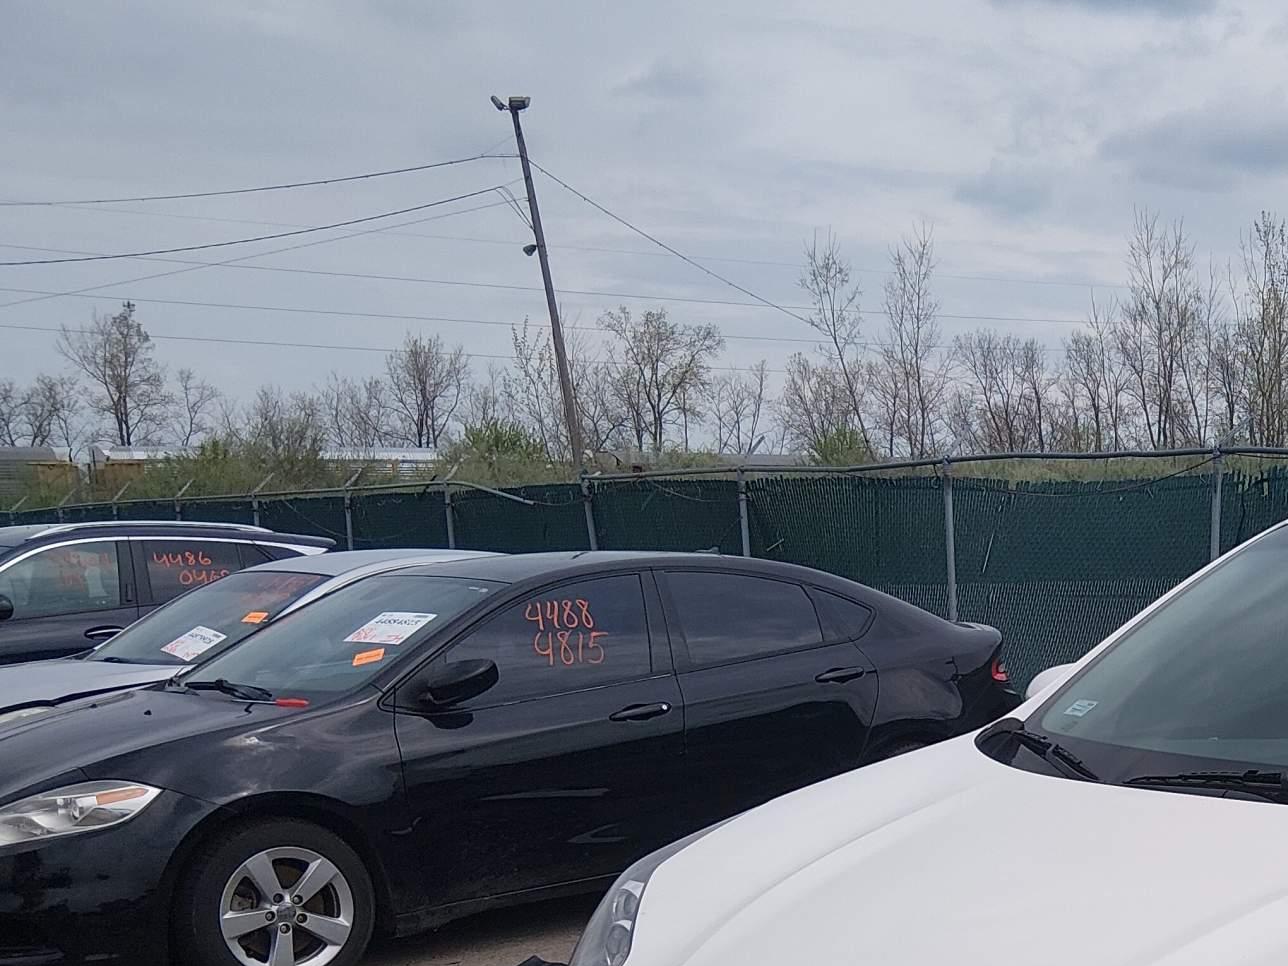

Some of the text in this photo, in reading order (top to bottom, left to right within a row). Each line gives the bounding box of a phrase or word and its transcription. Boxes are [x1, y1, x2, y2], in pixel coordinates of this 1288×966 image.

[153, 551, 212, 568] 4486
[525, 599, 594, 631] 4488
[534, 630, 609, 666] 4815
